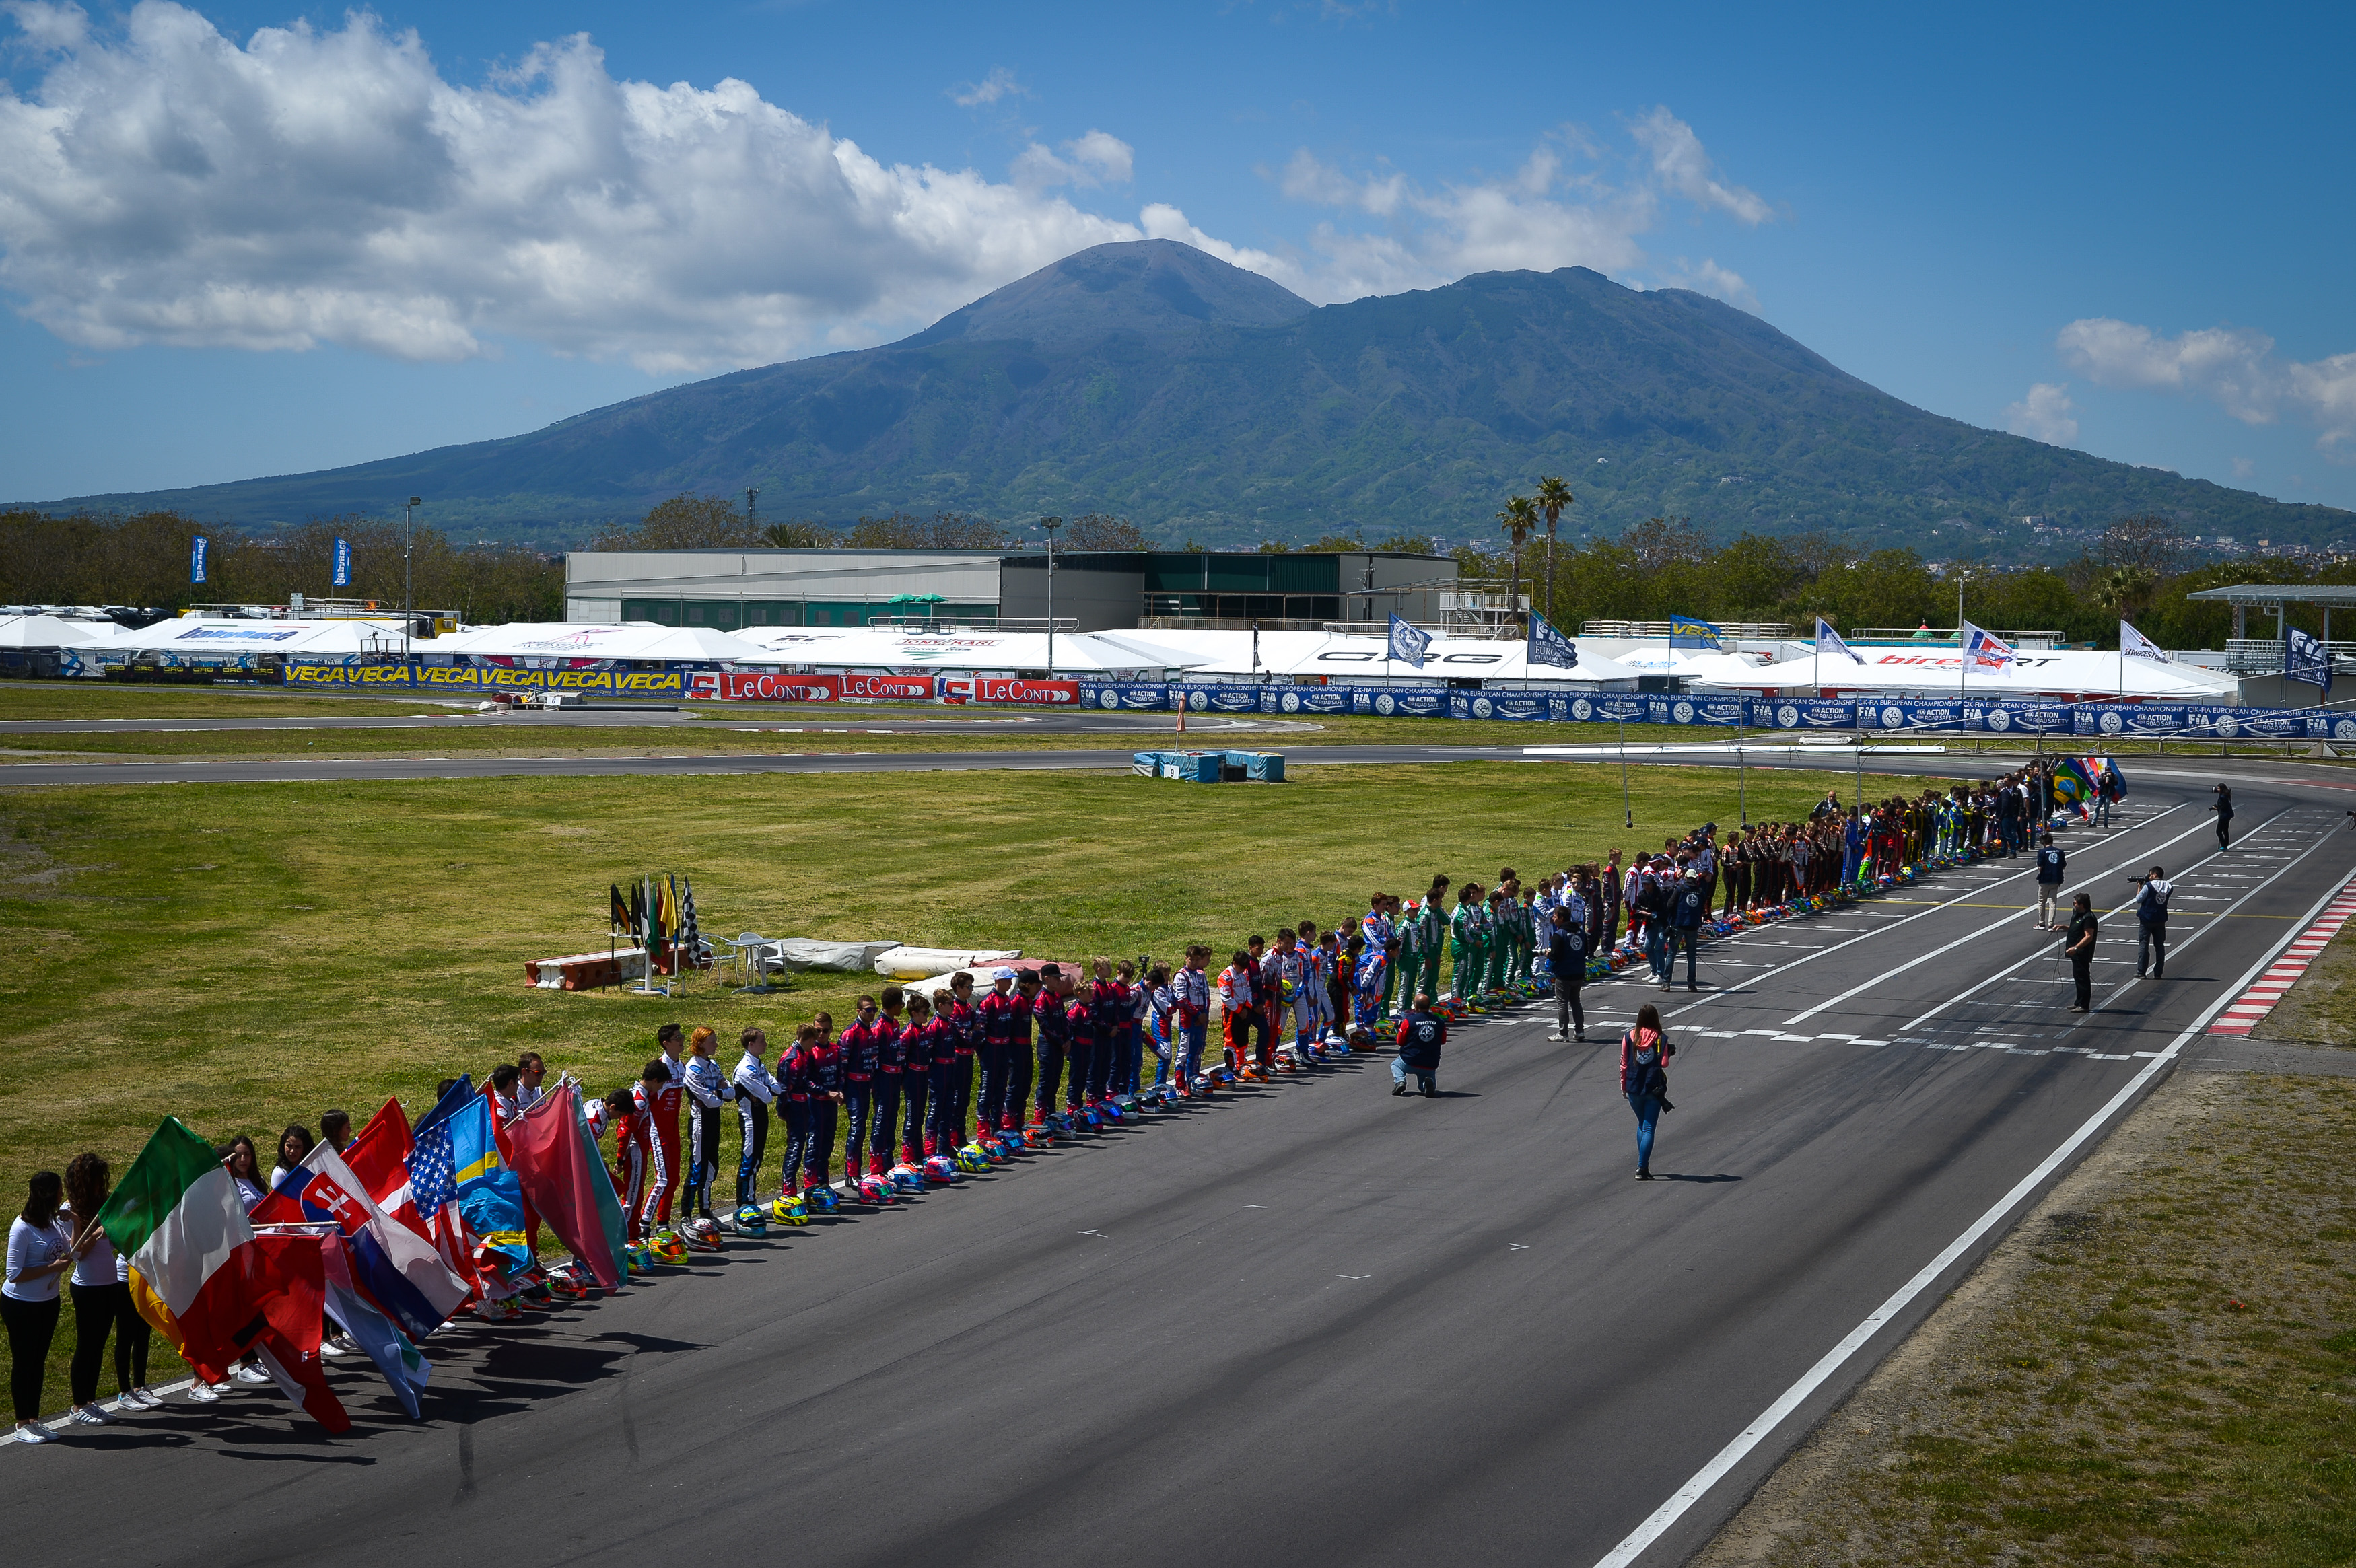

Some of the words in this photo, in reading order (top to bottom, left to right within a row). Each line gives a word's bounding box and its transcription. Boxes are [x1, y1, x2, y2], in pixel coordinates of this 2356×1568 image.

[285, 666, 345, 681] VEGA
[347, 666, 410, 682] VEGA
[415, 666, 478, 684] VEGA
[481, 668, 544, 686] VEGA
[547, 671, 611, 688] VEGA
[615, 673, 681, 689] VEGA
[1261, 692, 1276, 702] FIA
[1354, 694, 1370, 703] FIA
[1649, 702, 1668, 711] FIA
[1753, 705, 1772, 715] FIA
[1859, 707, 1877, 717] FIA
[1964, 709, 1982, 719] FIA
[2075, 711, 2093, 722] FIA
[2188, 714, 2209, 725] FIA
[2307, 719, 2328, 729] FIA
[1171, 769, 1174, 777] 9
